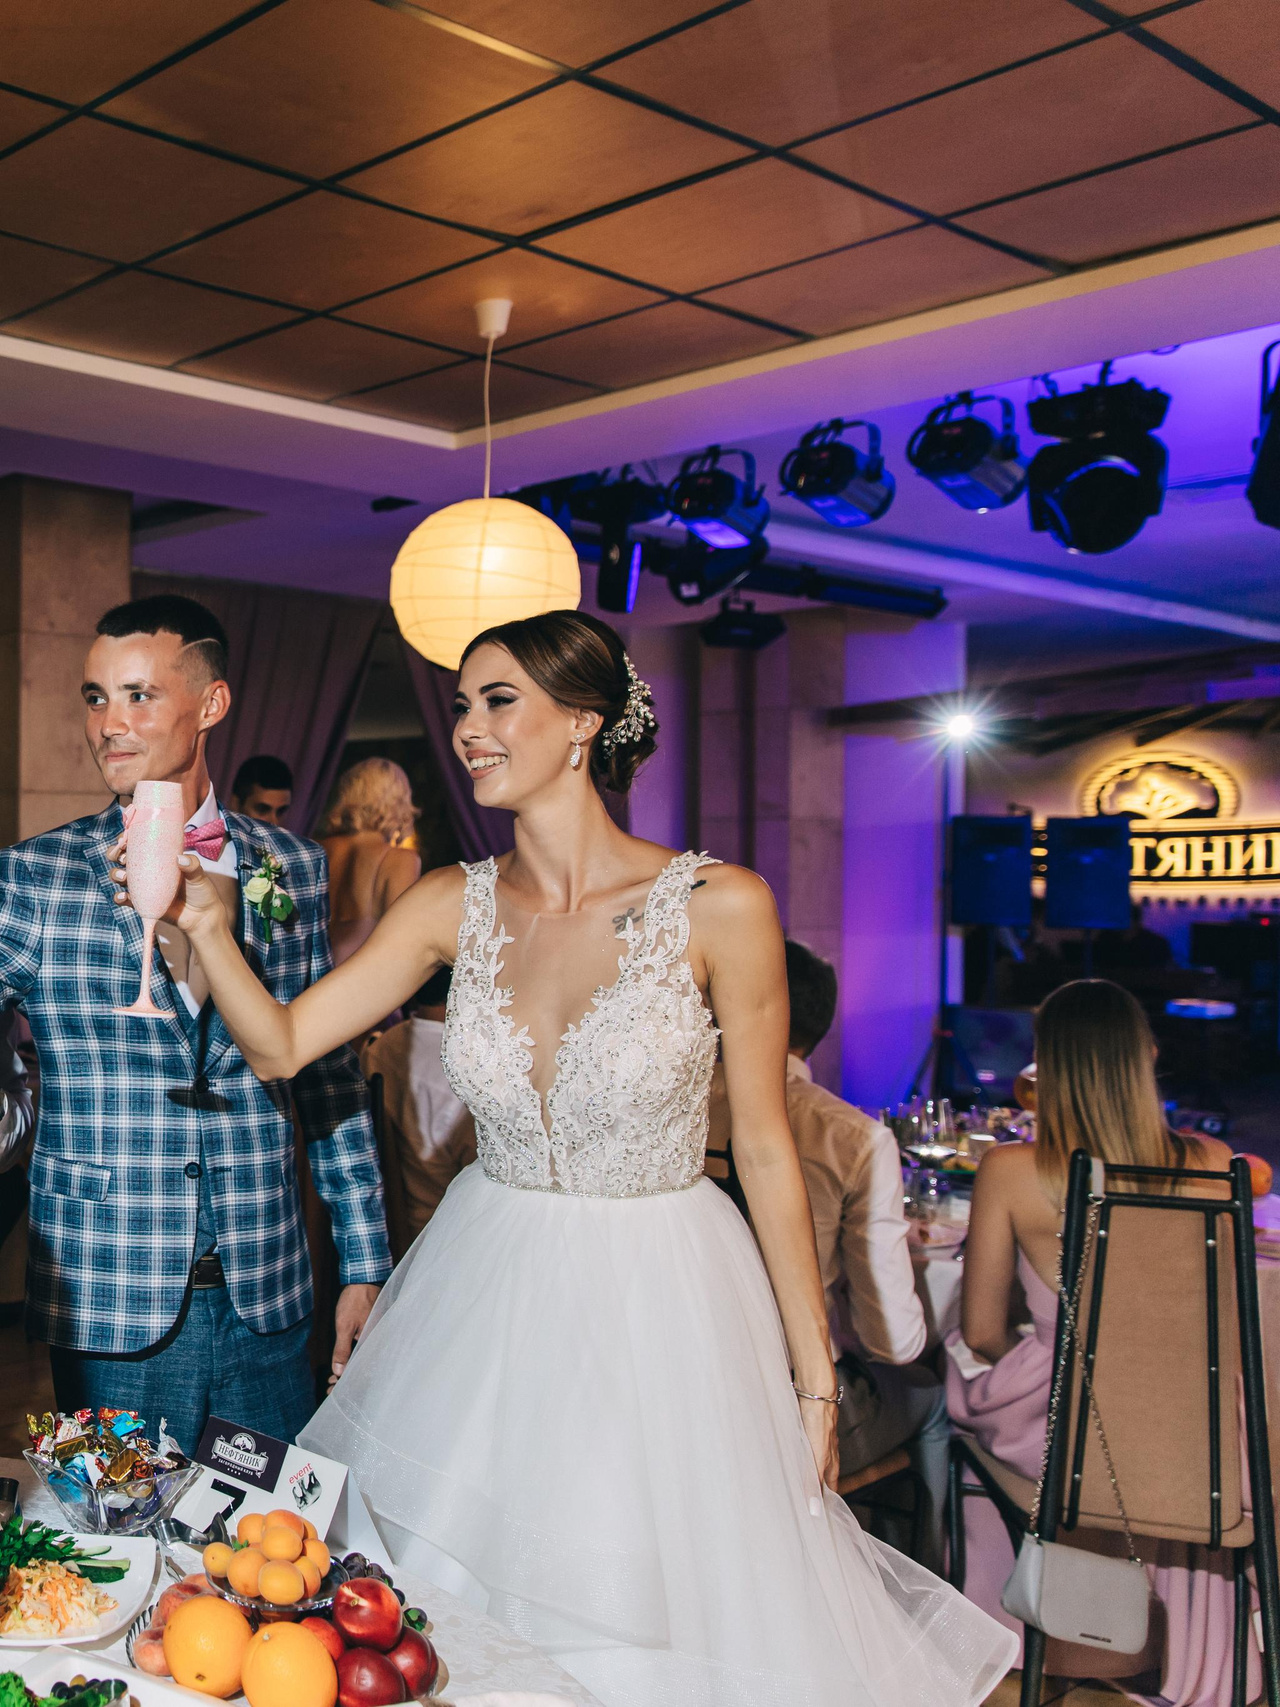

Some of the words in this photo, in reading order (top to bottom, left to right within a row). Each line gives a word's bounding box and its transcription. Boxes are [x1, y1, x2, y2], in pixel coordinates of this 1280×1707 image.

[1129, 834, 1280, 877] ТЯНИ
[218, 1444, 261, 1467] НЕФТЯНИК
[288, 1463, 312, 1484] event
[211, 1479, 247, 1521] 7
